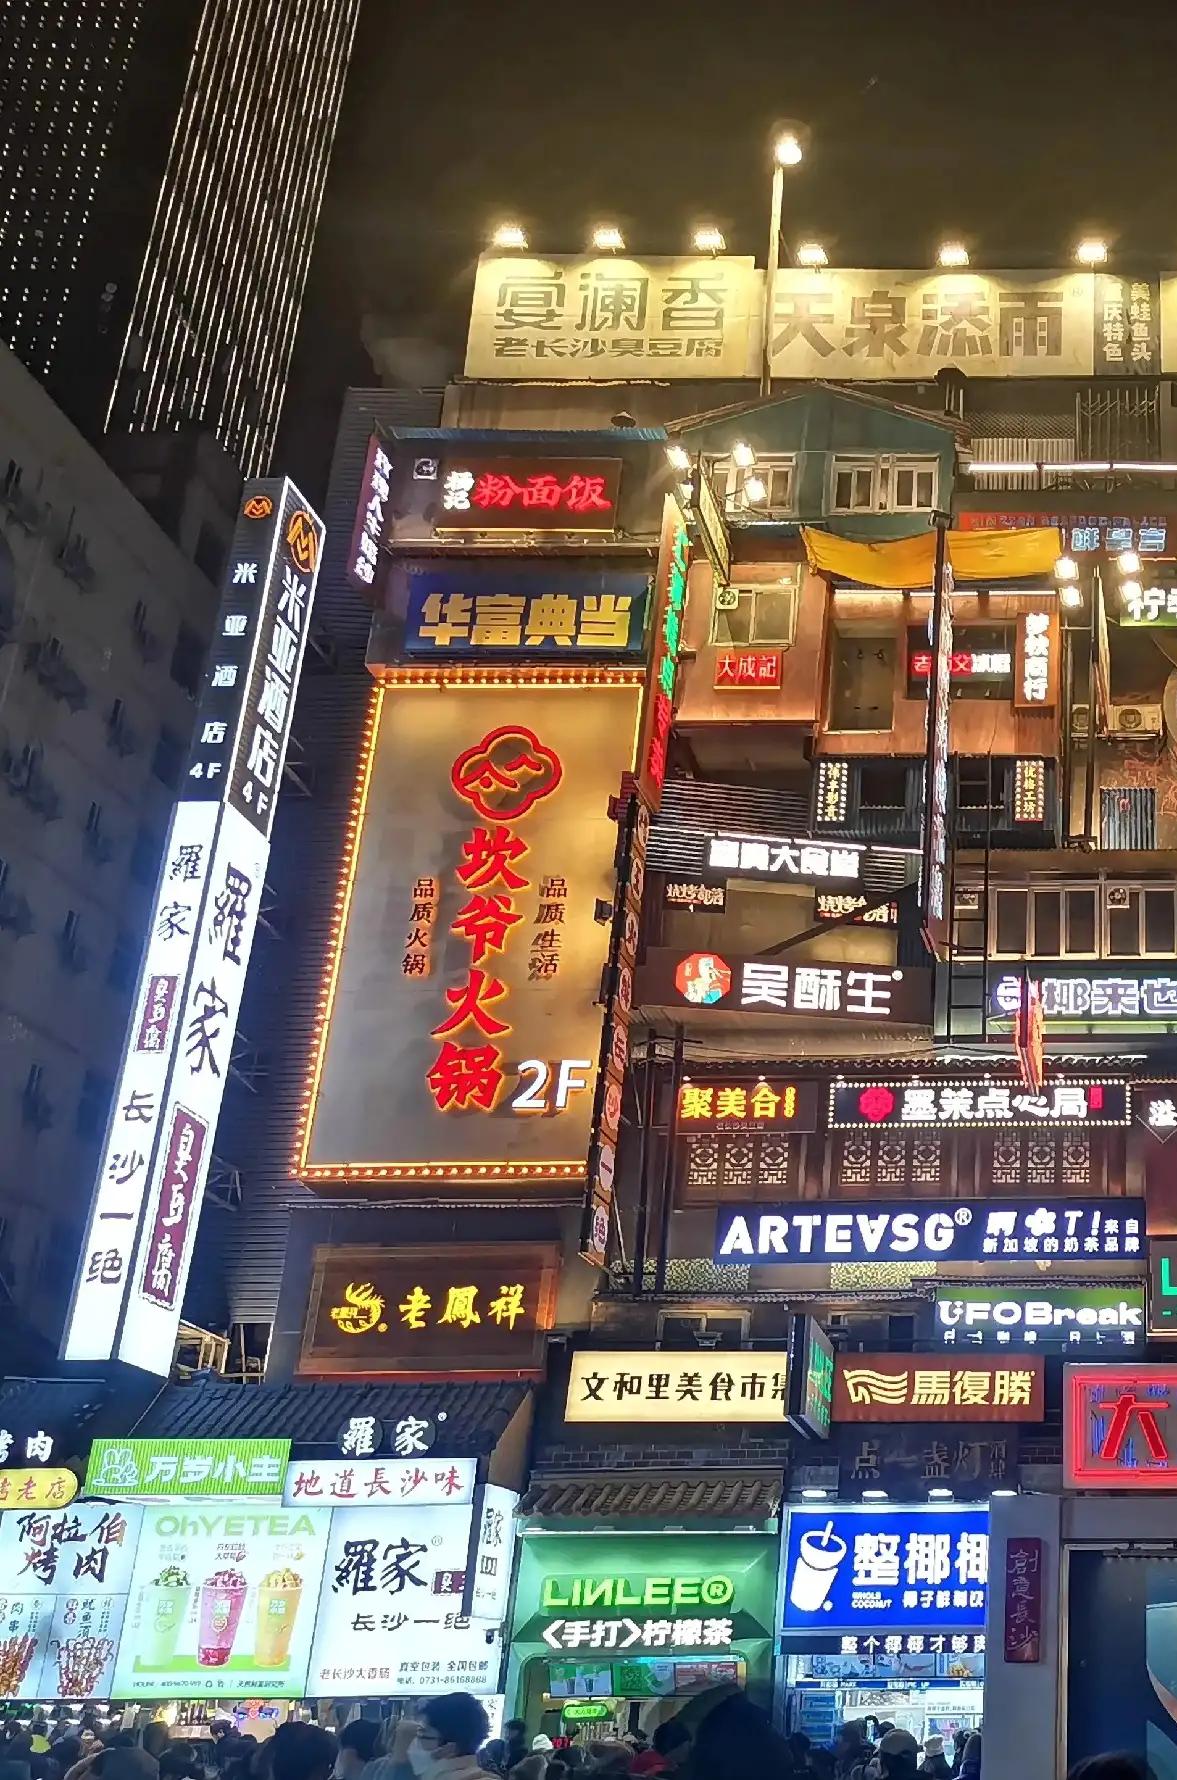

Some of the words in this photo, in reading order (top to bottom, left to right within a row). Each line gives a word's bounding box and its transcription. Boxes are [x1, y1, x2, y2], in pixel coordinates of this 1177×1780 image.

[772, 289, 1064, 358] 天泉添雨
[493, 336, 724, 358] 老长沙臭豆腐
[474, 473, 613, 511] 粉面饭
[419, 593, 632, 647] 华富典当
[200, 563, 257, 744] 米亚酒店
[716, 653, 778, 679] 大成記
[189, 763, 222, 779] 4F
[242, 781, 269, 815] 4F
[158, 844, 204, 942] 羅家
[402, 877, 435, 976] 品质火锅
[536, 876, 568, 976] 品质生活
[426, 826, 530, 1111] 坎爷火锅
[511, 1059, 595, 1110] 2F
[680, 1087, 781, 1119] 聚美合
[901, 1087, 1087, 1120] 墨茉点心局
[86, 1089, 155, 1284] 长沙一绝
[982, 1236, 1140, 1253] 新加坡的奶茶品牌
[398, 1285, 525, 1330] 老鳳祥
[910, 1370, 1032, 1405] 馬復勝
[342, 1416, 430, 1455] 羅家
[293, 1466, 465, 1499] 地道長沙味
[16, 1512, 127, 1547] 阿拉伯
[17, 1547, 110, 1586] 烤肉
[331, 1537, 428, 1596] 羅家
[351, 1612, 471, 1631] 长沙一绝
